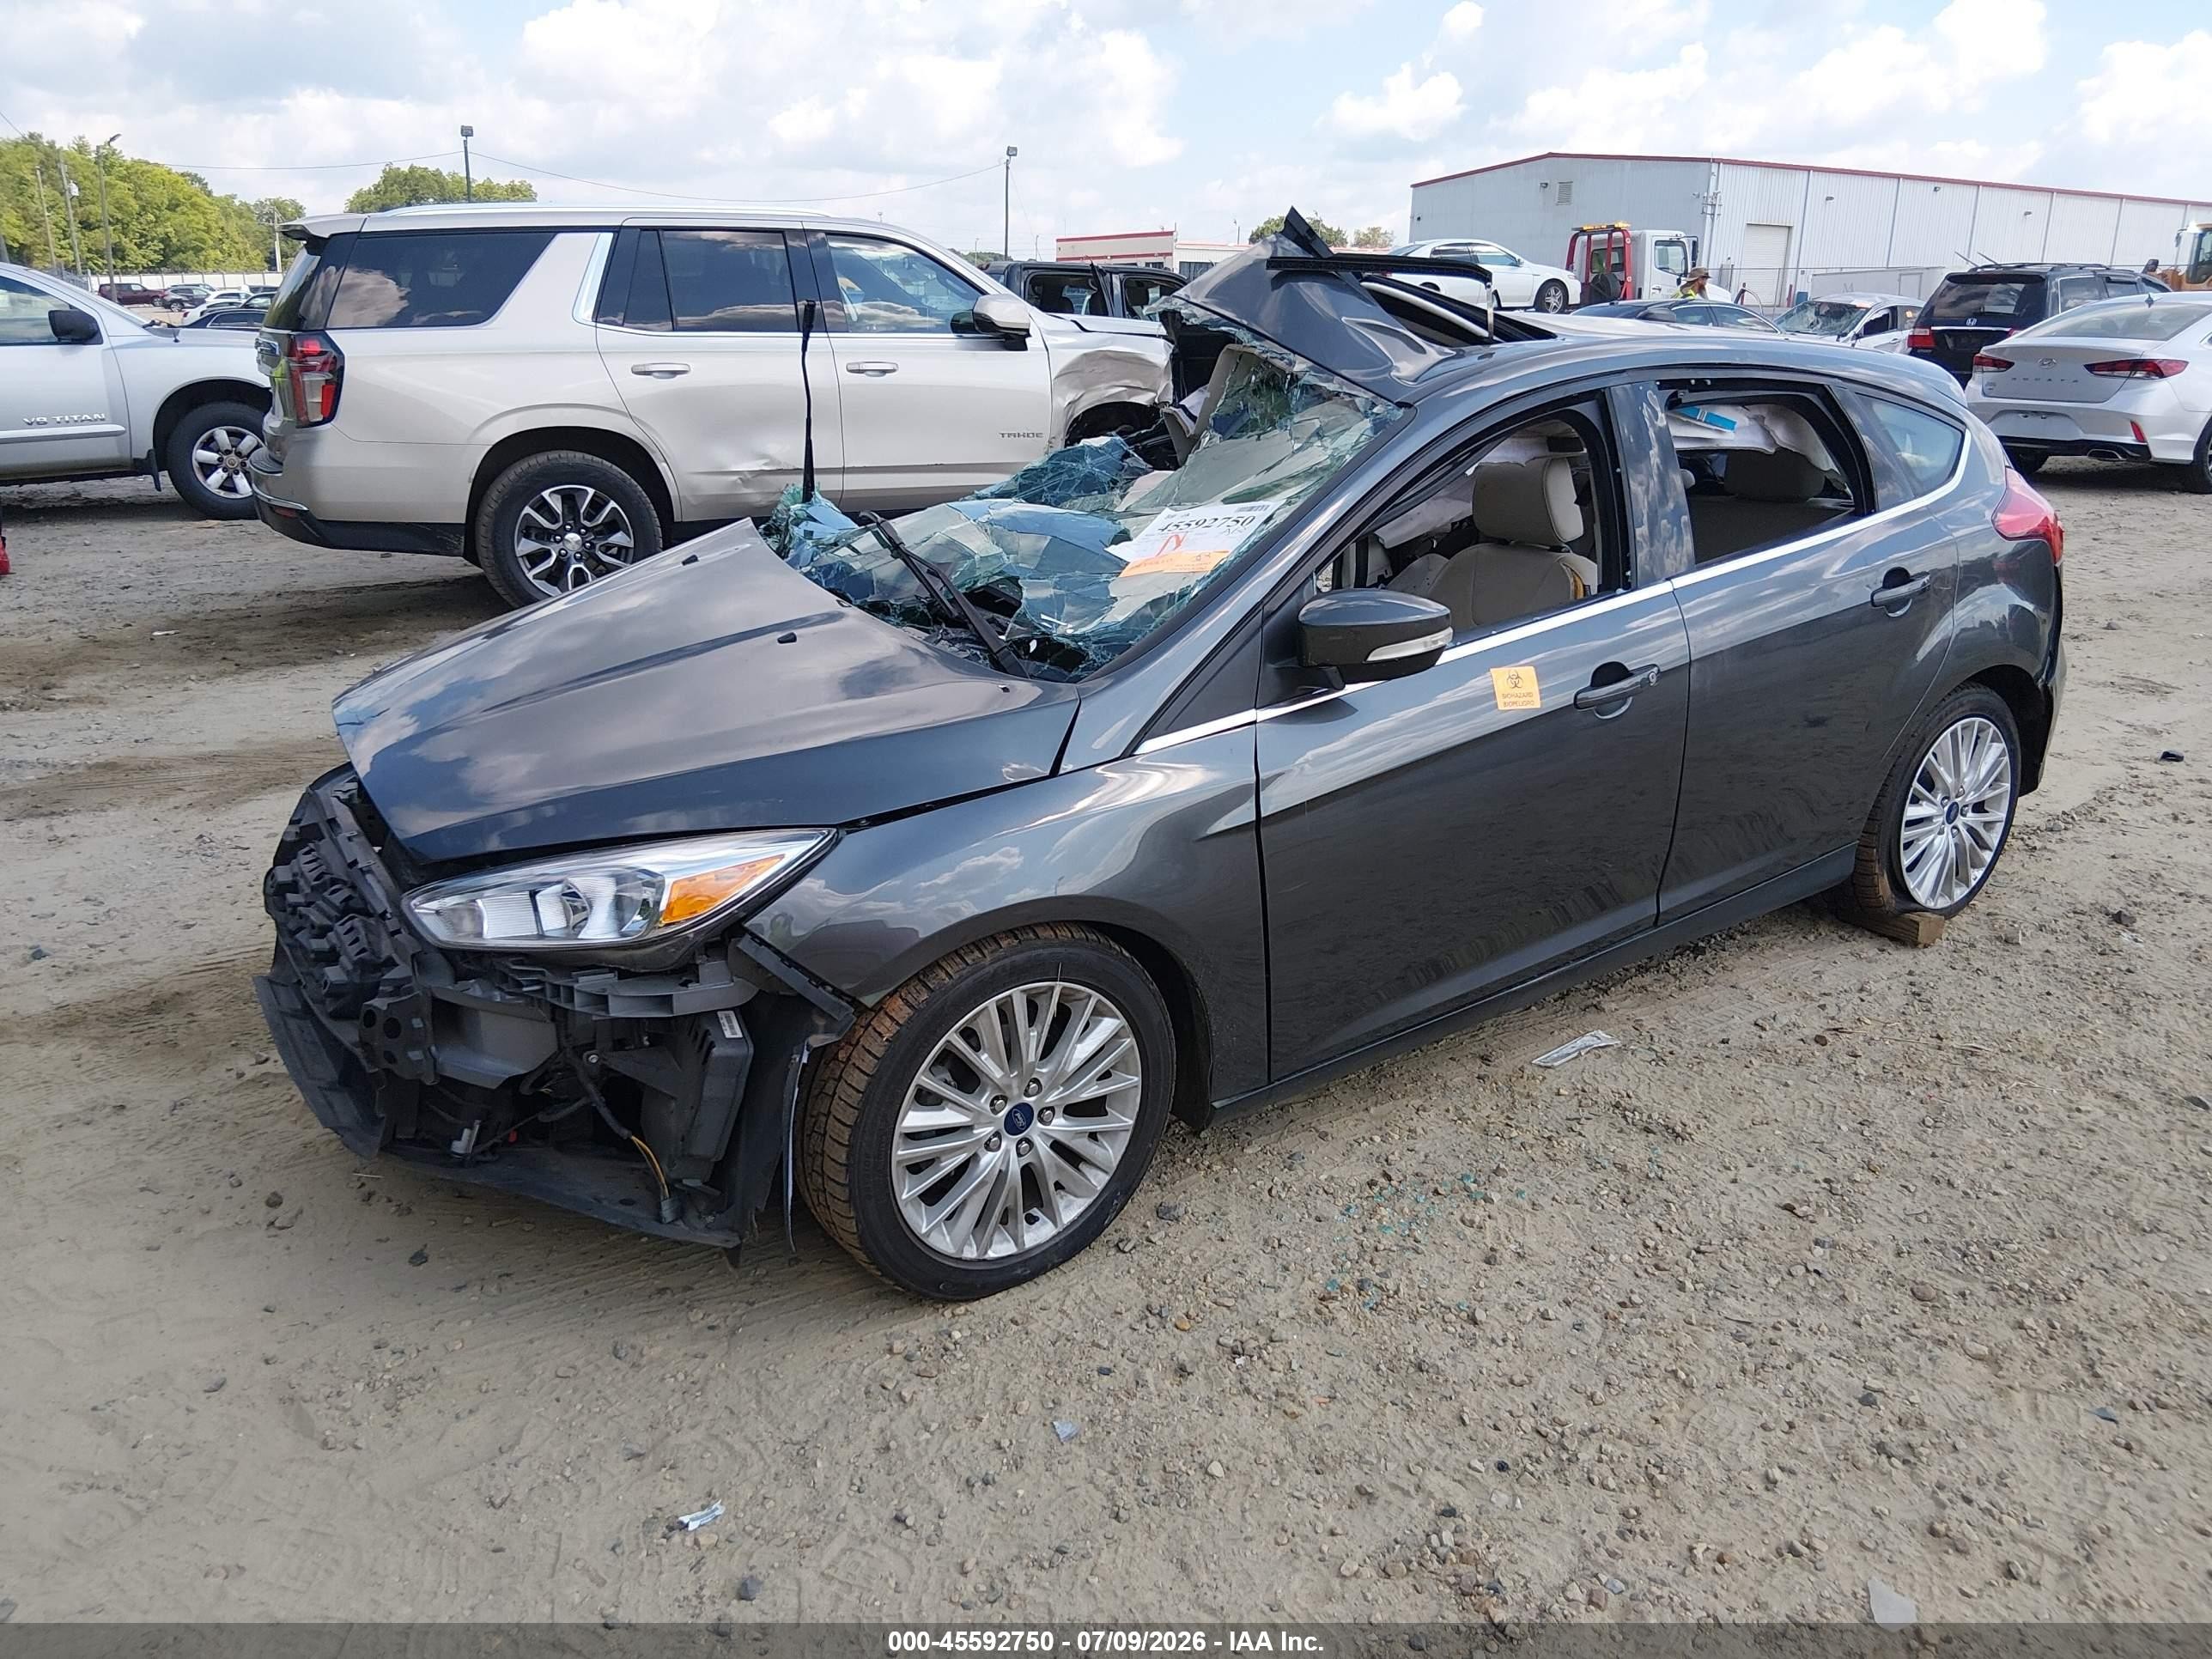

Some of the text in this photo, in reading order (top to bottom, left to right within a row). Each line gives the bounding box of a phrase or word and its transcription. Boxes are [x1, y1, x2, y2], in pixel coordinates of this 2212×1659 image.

[23, 412, 106, 426] V8 TITAN
[1158, 515, 1256, 532] 45592750
[1501, 691, 1534, 700] BIOHAZARD
